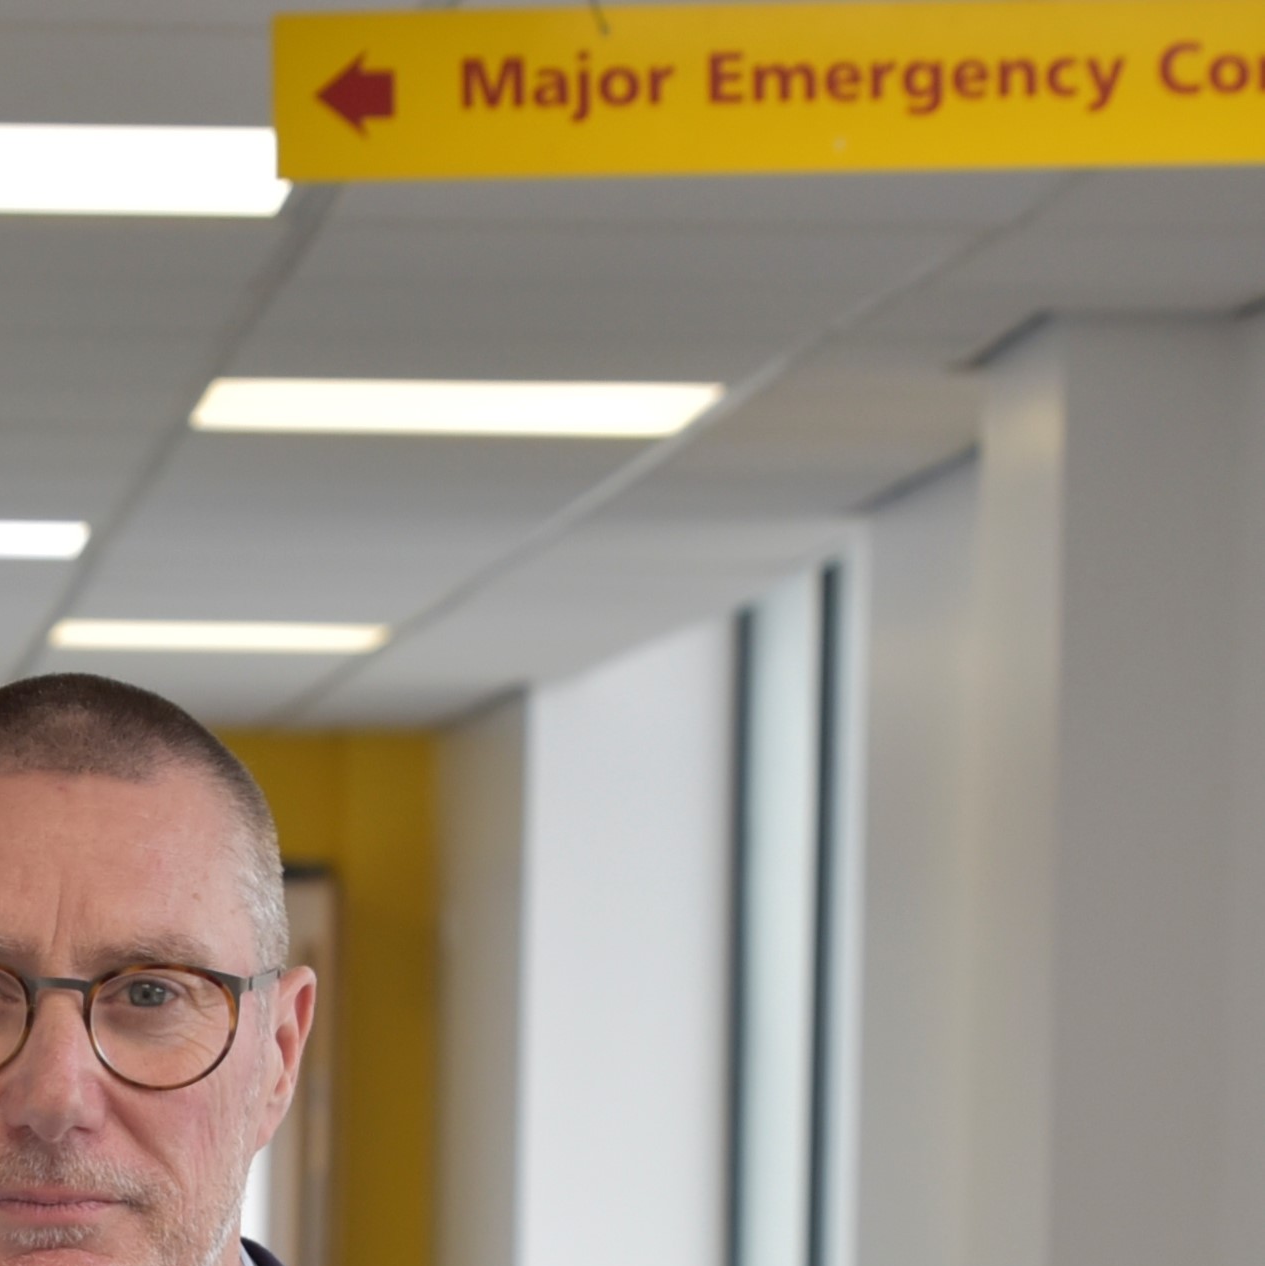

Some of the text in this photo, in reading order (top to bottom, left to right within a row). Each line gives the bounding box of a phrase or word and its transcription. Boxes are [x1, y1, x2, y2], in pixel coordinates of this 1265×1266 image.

[459, 42, 1265, 123] Major Emergency Co
